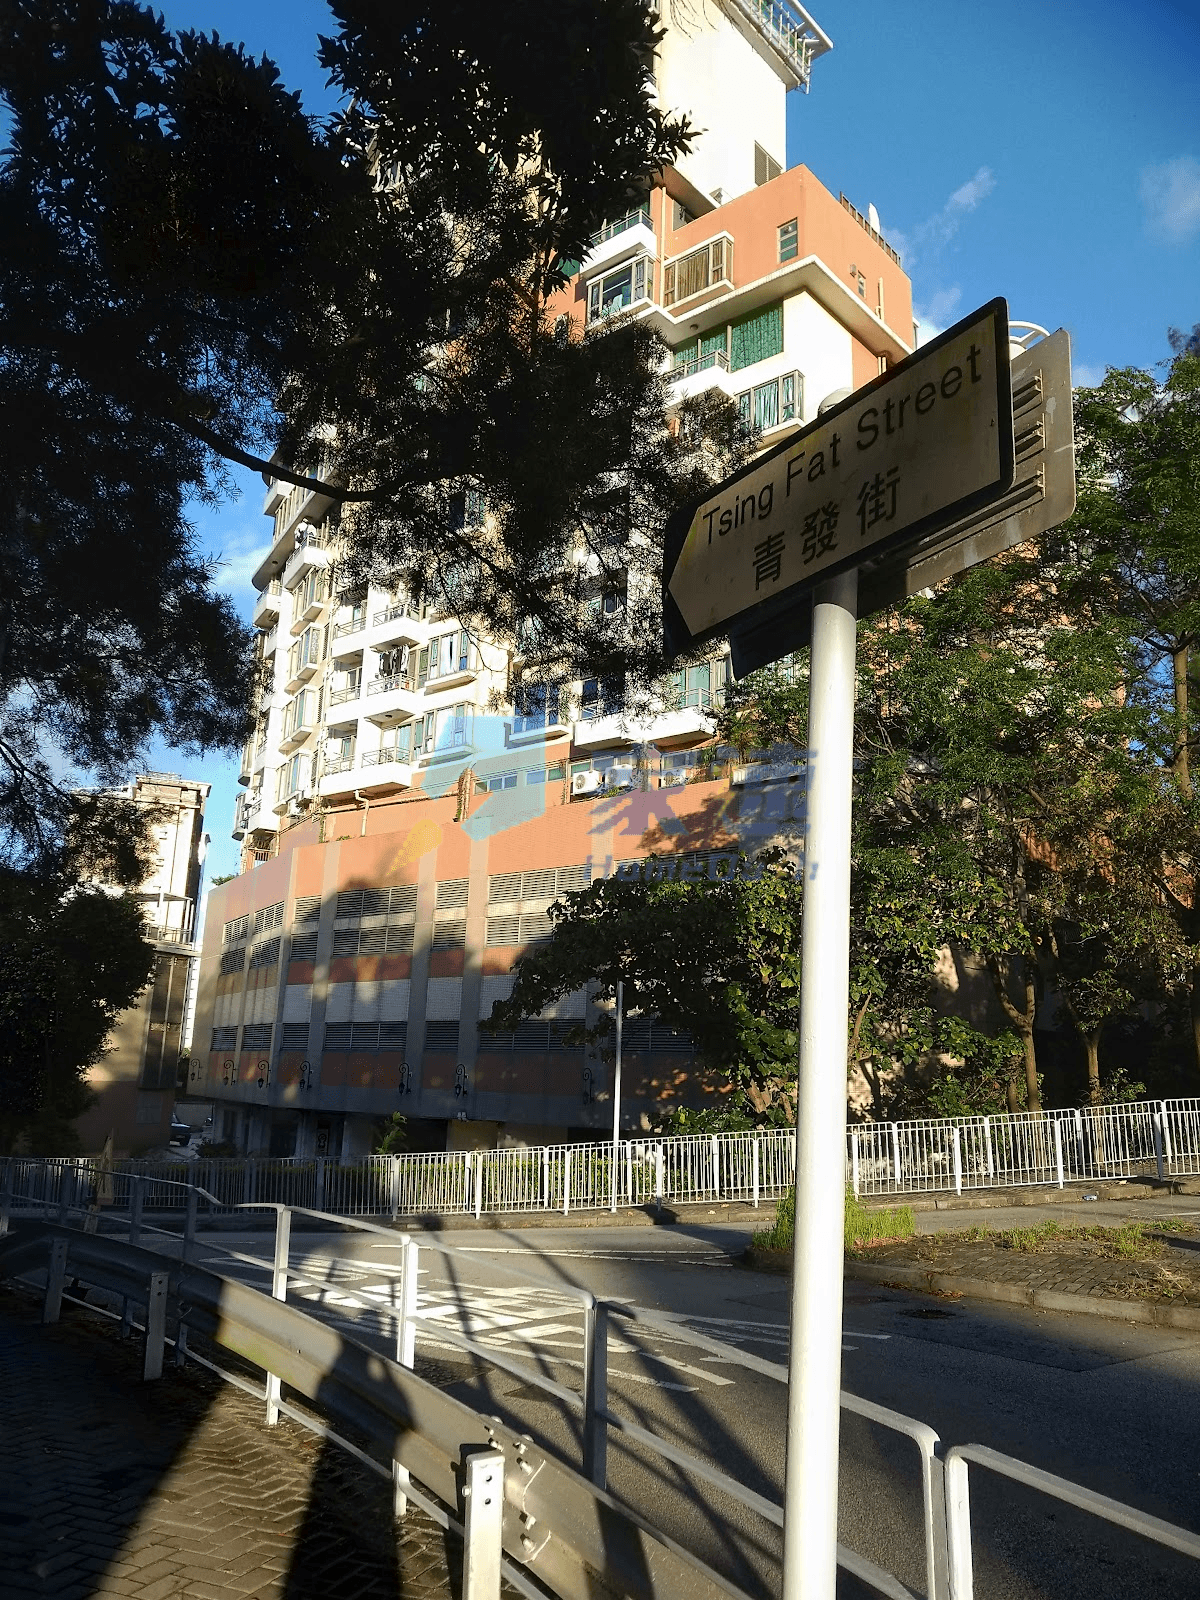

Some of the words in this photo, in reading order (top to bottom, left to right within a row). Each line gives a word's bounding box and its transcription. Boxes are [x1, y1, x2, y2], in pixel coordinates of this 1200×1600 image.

[702, 481, 774, 545] Tsing
[785, 433, 841, 497] Fat
[856, 343, 982, 450] Street
[752, 466, 900, 591] 青發街
